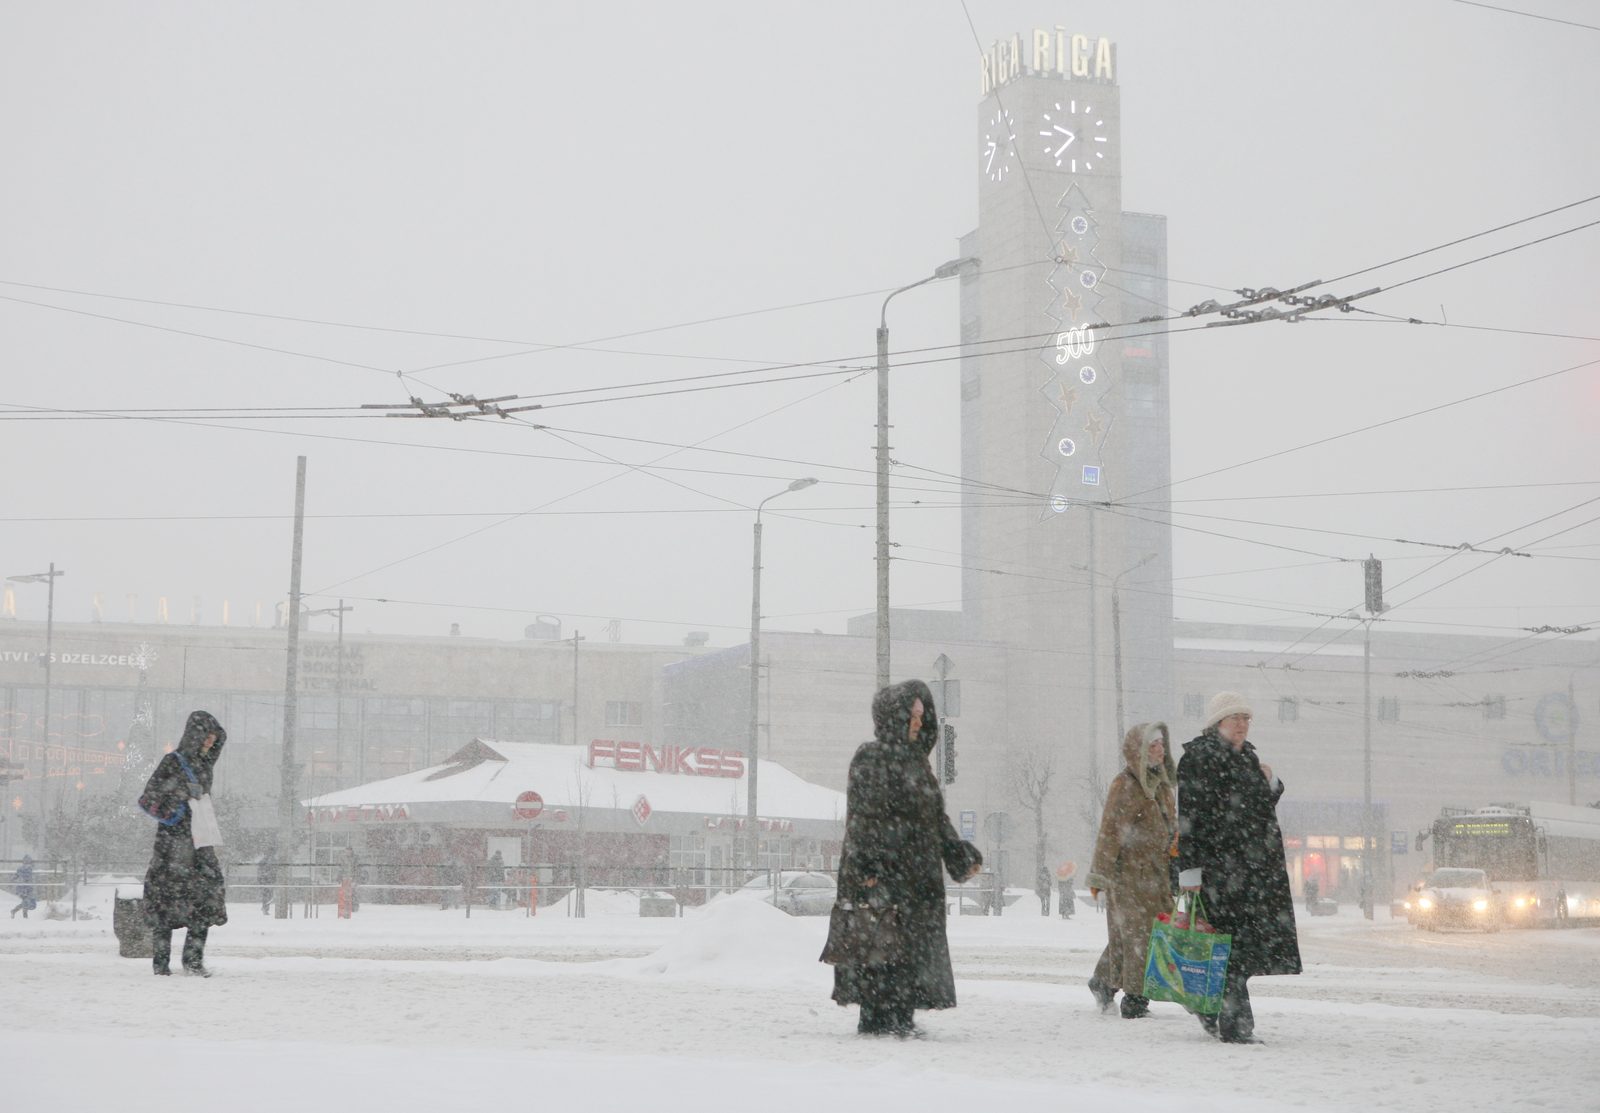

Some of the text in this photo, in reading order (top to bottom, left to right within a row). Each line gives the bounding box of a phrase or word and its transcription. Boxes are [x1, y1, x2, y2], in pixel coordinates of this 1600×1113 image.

[980, 32, 1020, 97] RĪGA
[1032, 25, 1114, 81] RĪGA
[1056, 323, 1095, 365] 500
[0, 651, 57, 663] TVIS
[587, 738, 744, 779] FENIKSS
